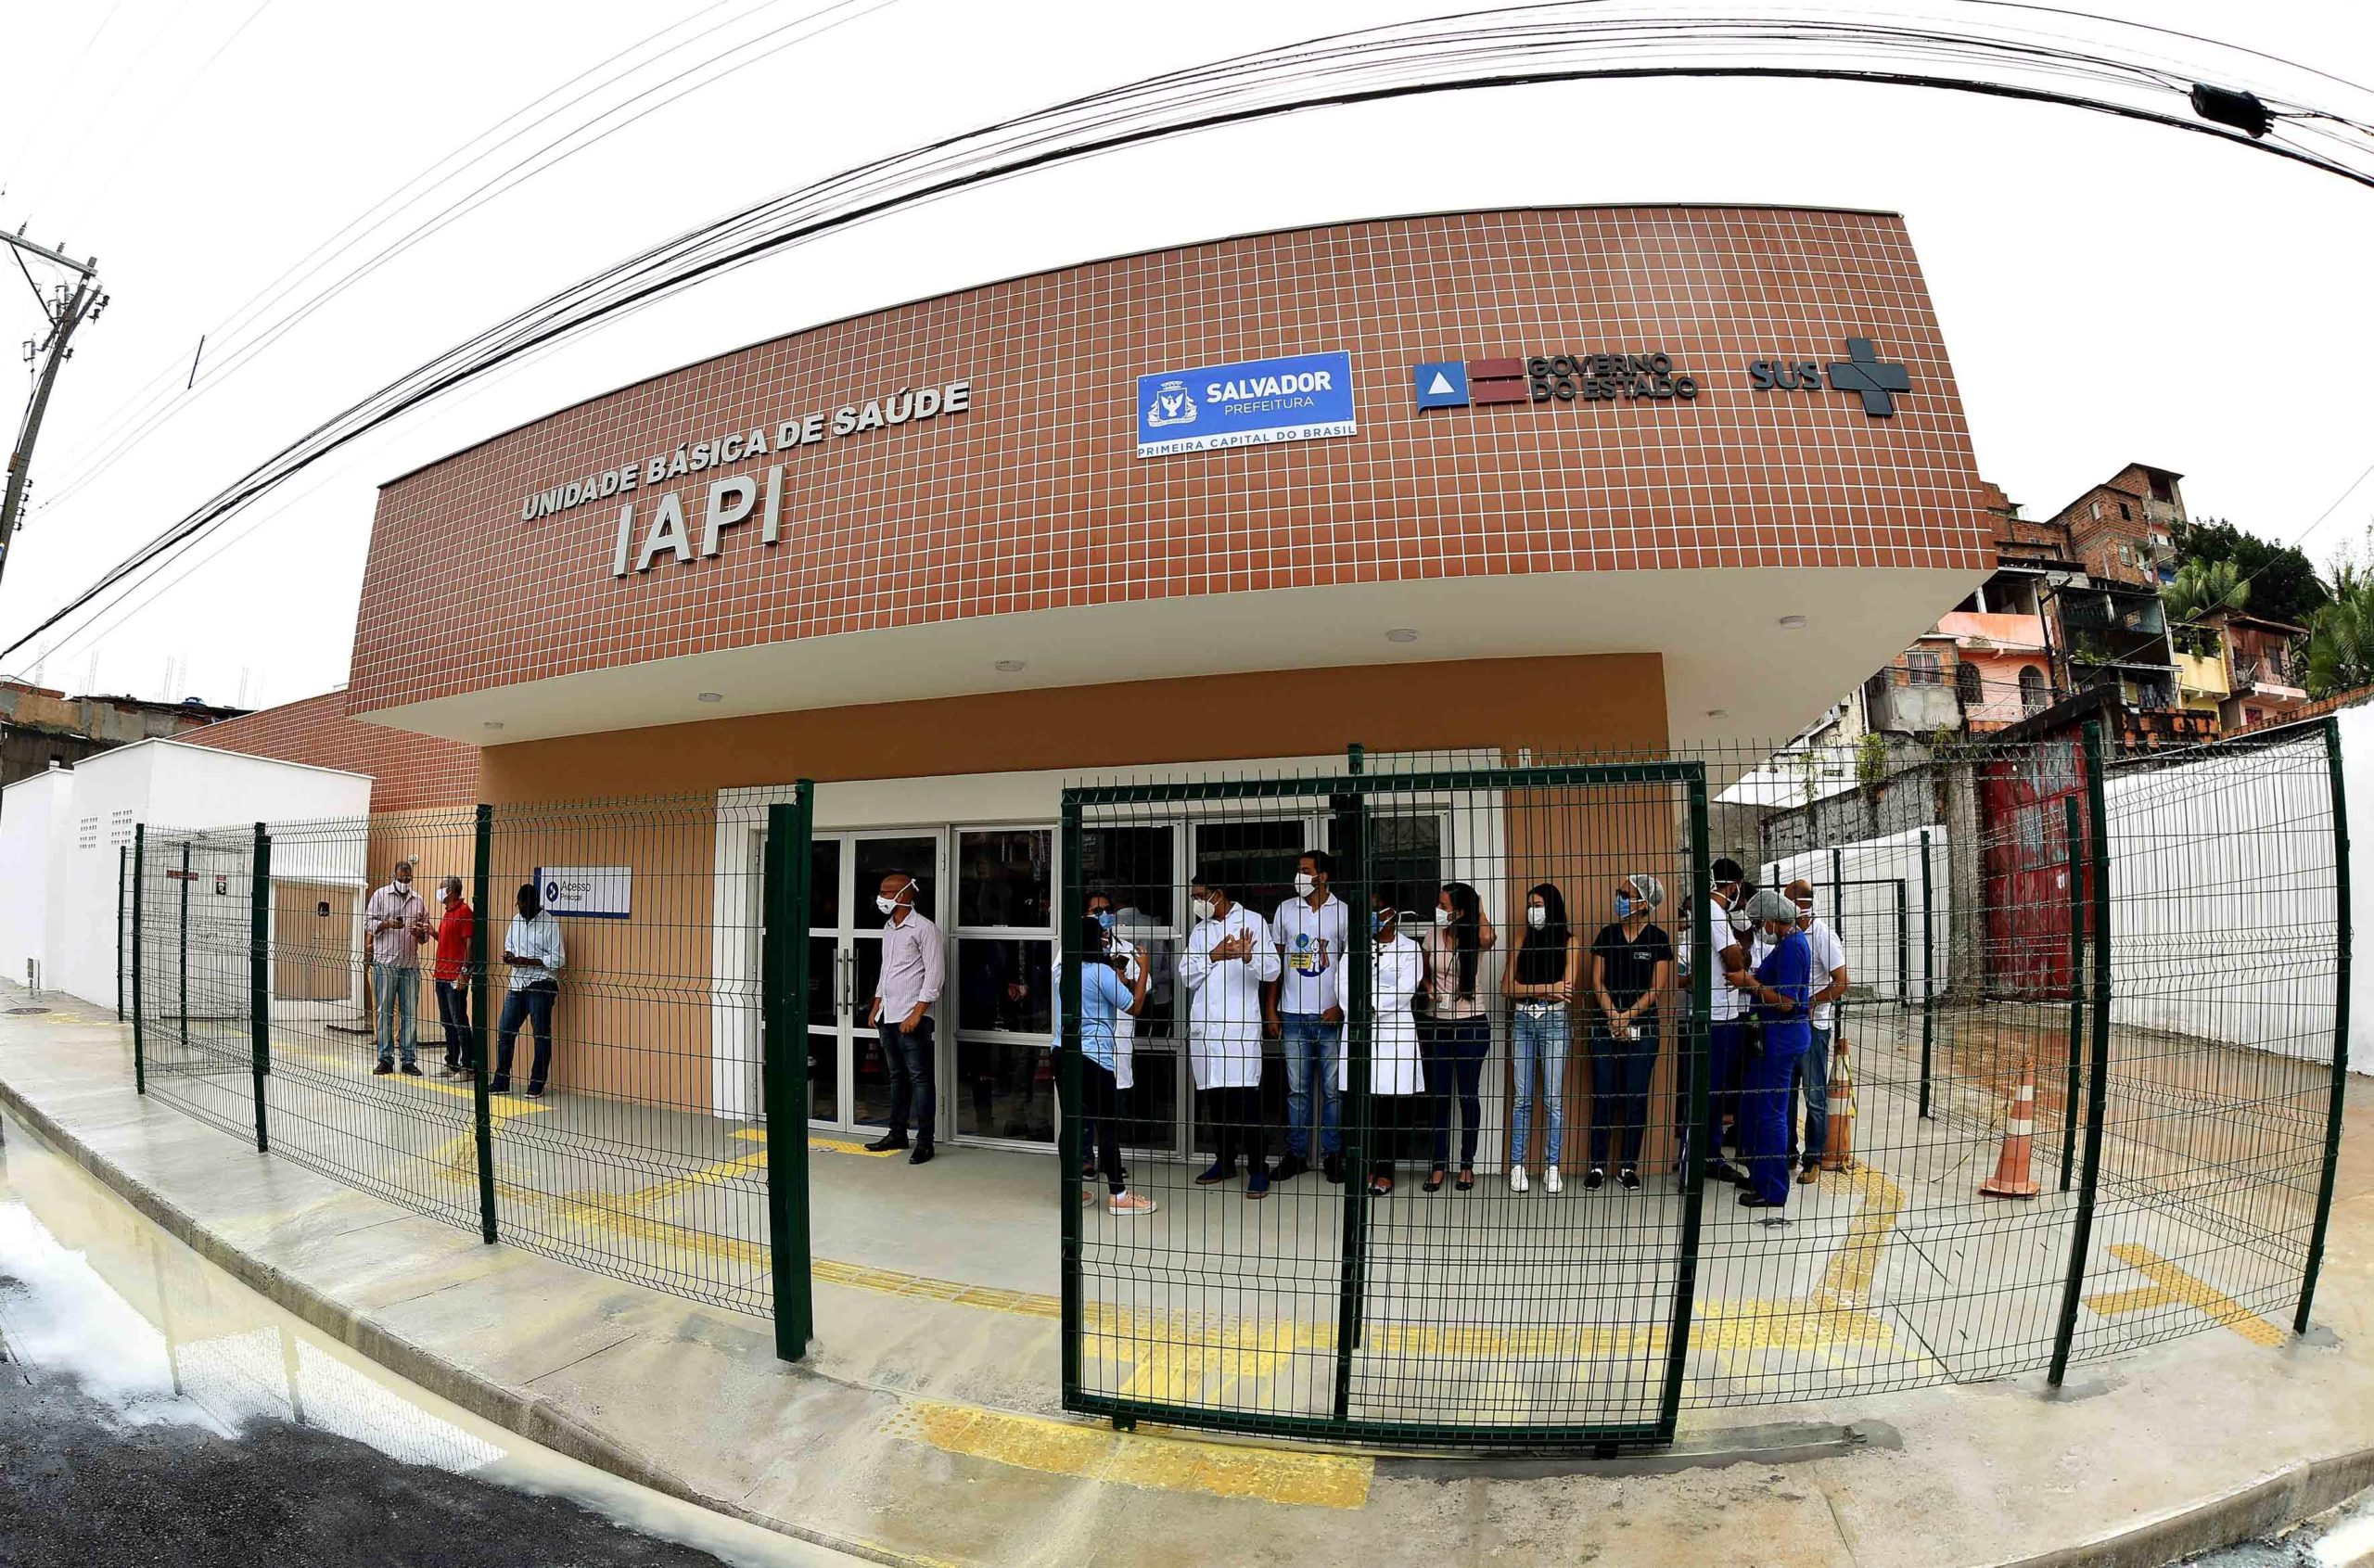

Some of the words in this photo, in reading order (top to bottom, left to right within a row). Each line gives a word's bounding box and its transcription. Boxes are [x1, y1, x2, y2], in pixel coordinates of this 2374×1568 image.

[1528, 352, 1672, 377] GOVERNO
[1750, 359, 1822, 391] SUS
[1206, 371, 1332, 403] SALVADOR
[1530, 376, 1576, 401] DO
[1582, 375, 1698, 400] ESTADO
[1224, 396, 1314, 415] PREFEITURA
[522, 465, 640, 521] UNIDADE
[646, 429, 769, 485] BÁSICA
[776, 414, 824, 450] DE
[833, 381, 970, 436] SAÚDE
[1138, 440, 1204, 457] PRIMEIRA
[1210, 433, 1270, 448] CAPITAL
[1277, 430, 1296, 440] DO
[1304, 426, 1356, 439] BRASIL
[613, 465, 786, 578] IAPI
[561, 881, 591, 891] Acesso
